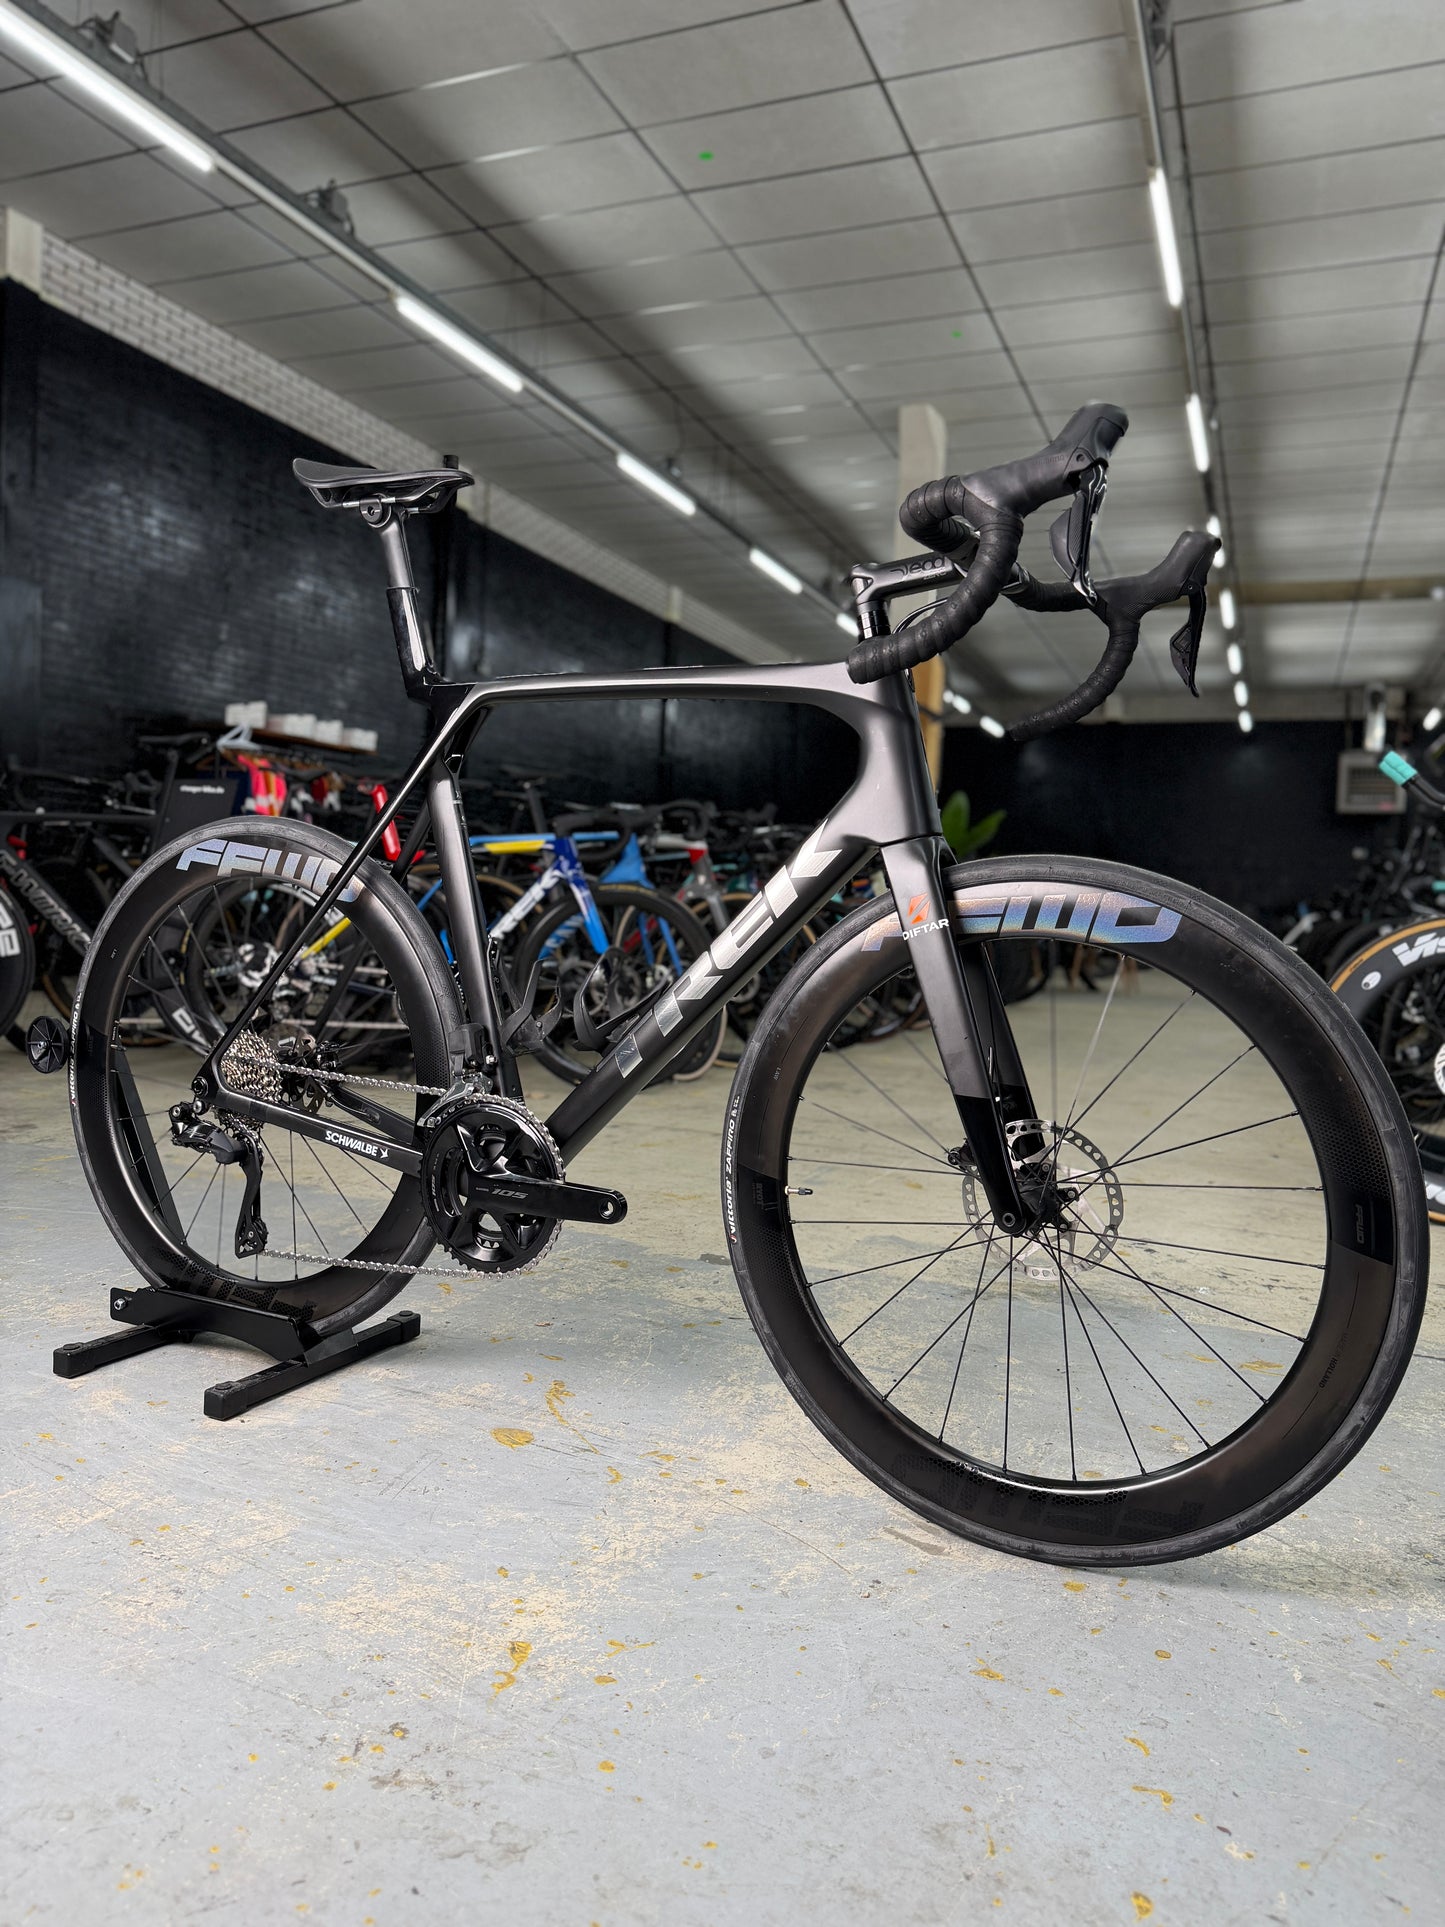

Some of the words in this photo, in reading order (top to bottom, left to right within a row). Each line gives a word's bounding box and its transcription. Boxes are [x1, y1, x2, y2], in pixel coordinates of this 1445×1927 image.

[653, 818, 843, 1038] TREK
[902, 918, 949, 942] DIFTAR
[325, 1130, 379, 1157] SCHWALBE
[725, 1120, 736, 1175] ZAFFIRO
[491, 1188, 529, 1200] 105
[1319, 1357, 1338, 1389] HOLLAND
